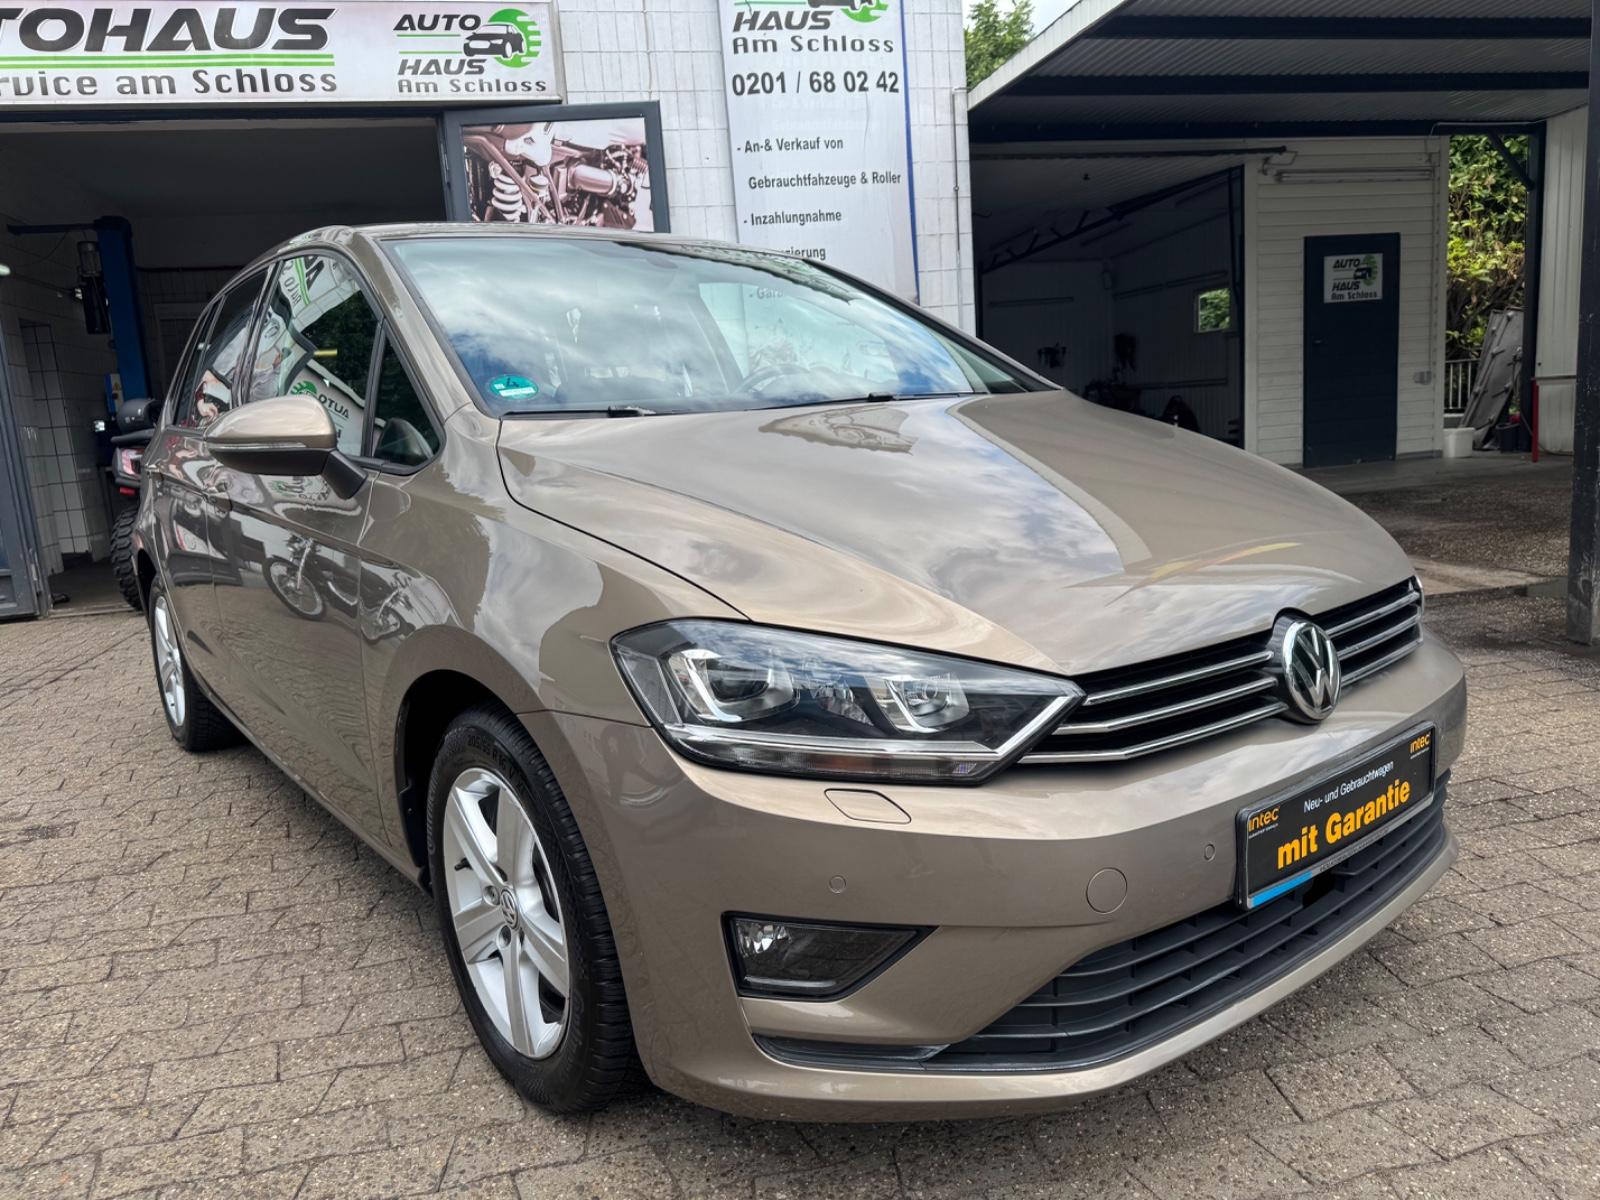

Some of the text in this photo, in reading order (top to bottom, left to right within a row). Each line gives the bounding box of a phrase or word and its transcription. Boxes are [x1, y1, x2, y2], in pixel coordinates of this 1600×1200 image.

[393, 14, 481, 31] AUTO
[733, 10, 834, 32] HAUS
[732, 35, 894, 55] Am Schloss
[397, 59, 487, 75] HAUS
[115, 75, 177, 95] am
[192, 68, 337, 94] Schloss
[397, 78, 547, 93] Am Schloss
[732, 70, 786, 96] 0201
[809, 70, 836, 93] 68
[843, 70, 869, 92] 02
[876, 70, 899, 93] 42
[776, 136, 820, 151] Verkauf
[825, 138, 843, 150] von
[748, 170, 901, 190] Gebrauchtfahzeuge & Roller
[751, 209, 842, 226] Inzahlungnahme
[784, 246, 826, 260] ierung
[1333, 258, 1361, 269] AUTO
[1332, 280, 1360, 292] HAUS
[1303, 761, 1395, 813] Neu- und Gebrauchtwagen
[1248, 806, 1280, 833] intec
[1277, 824, 1318, 870] mit
[1326, 779, 1411, 845] Garantie
